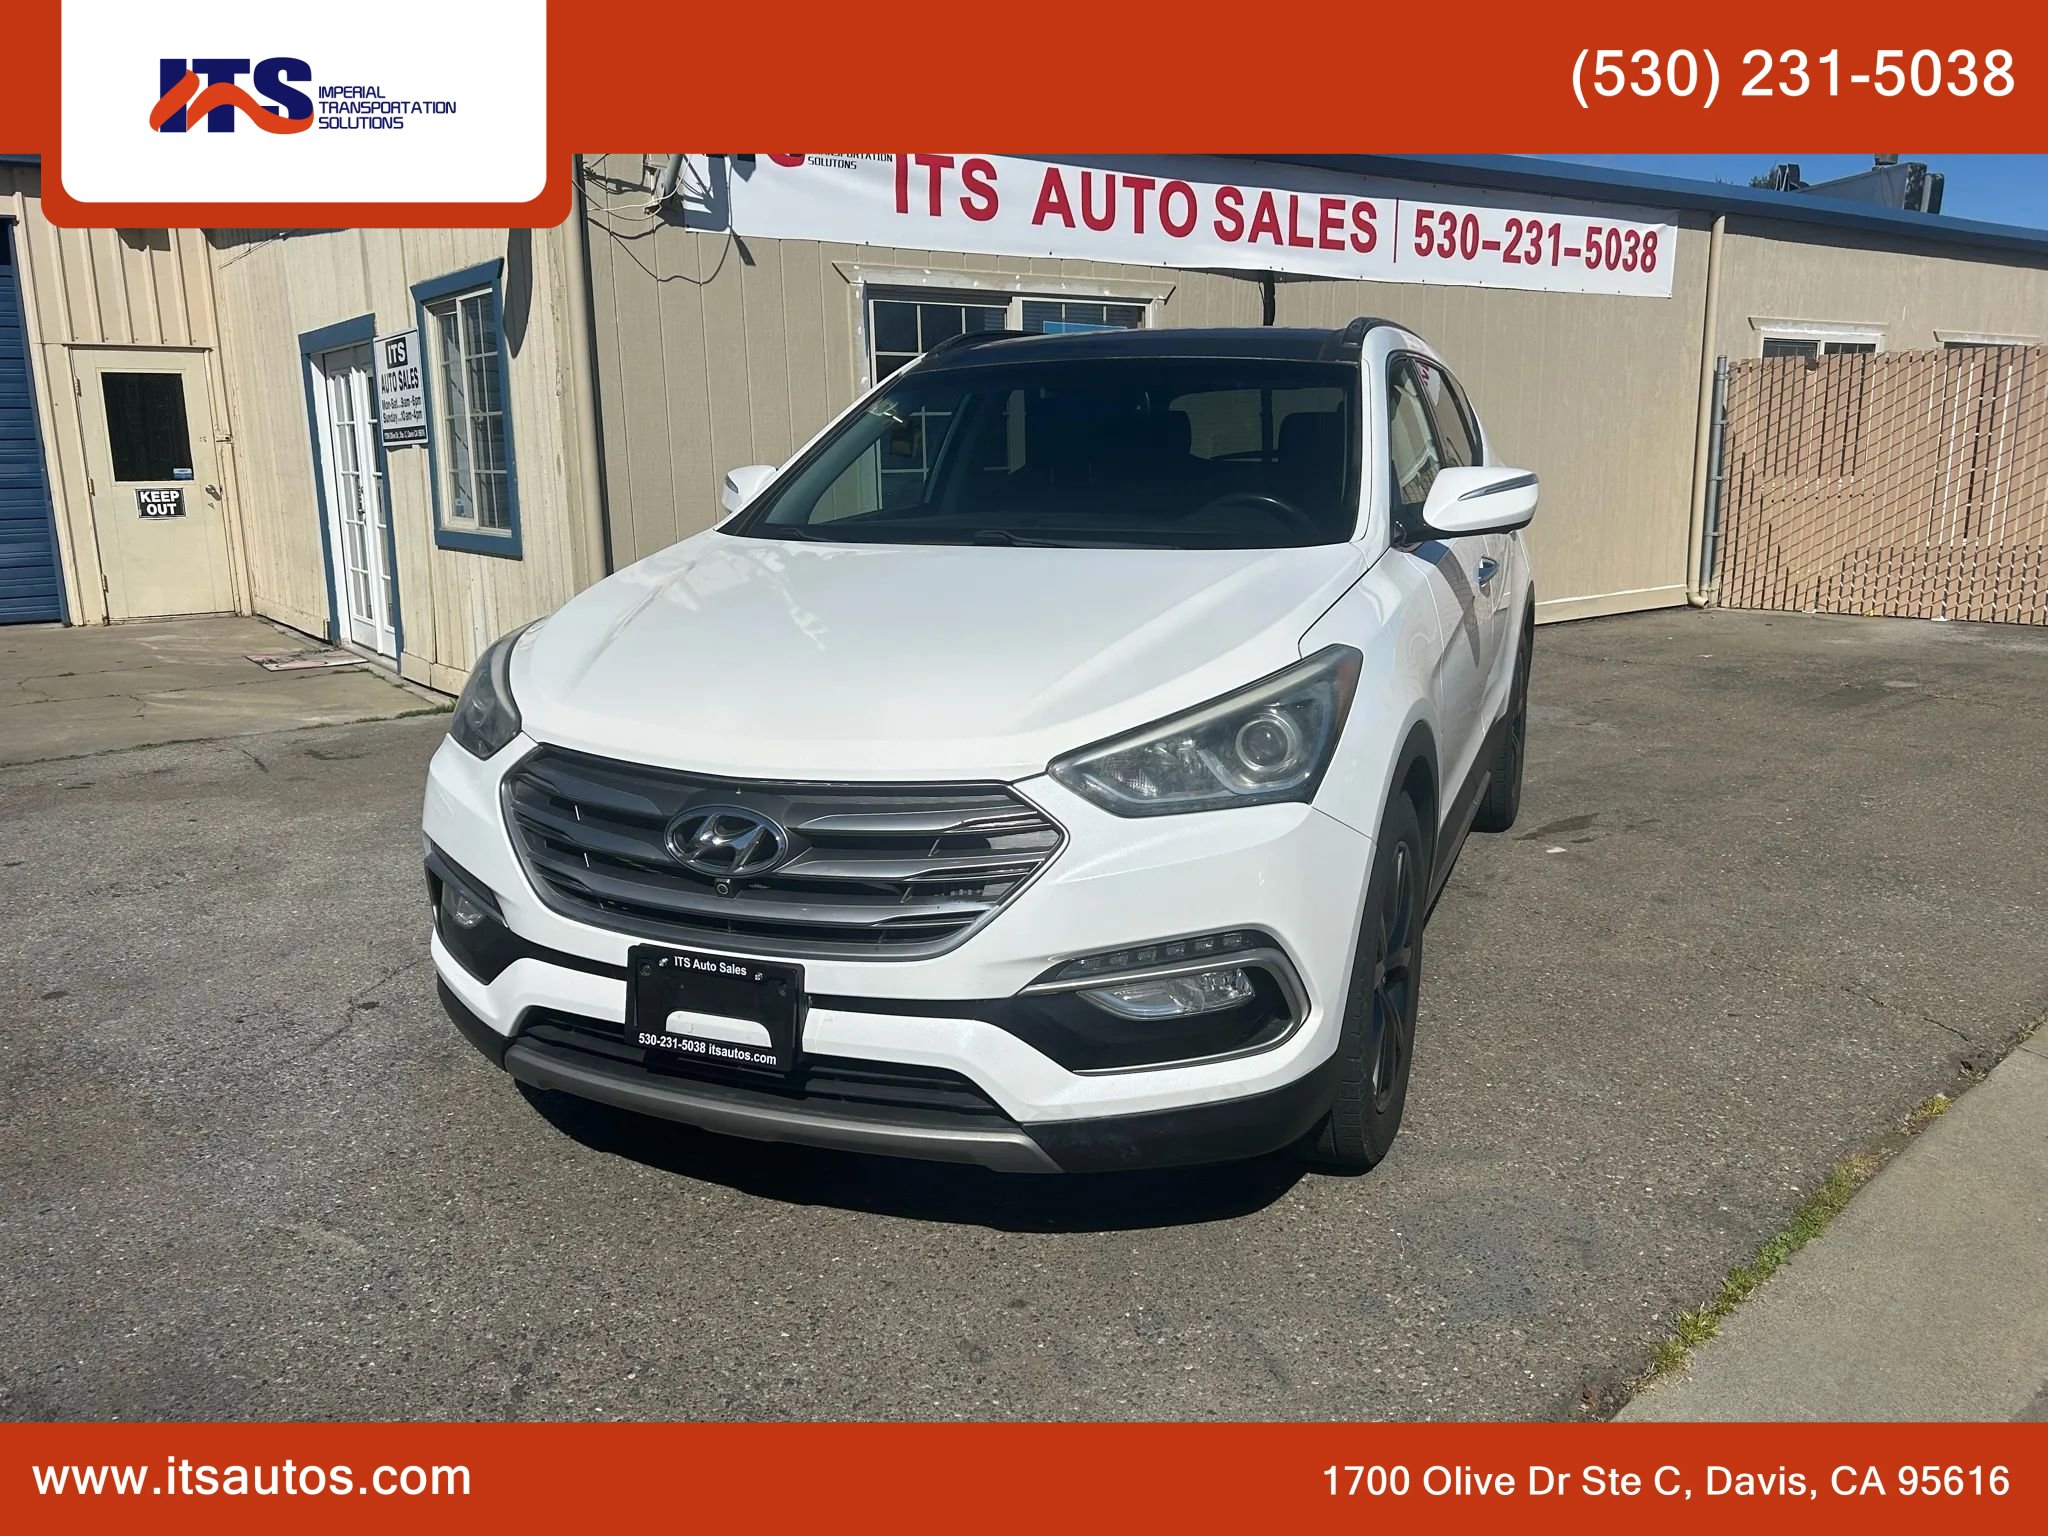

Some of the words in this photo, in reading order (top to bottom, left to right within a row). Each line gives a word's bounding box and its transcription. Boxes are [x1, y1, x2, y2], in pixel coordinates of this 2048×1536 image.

[895, 153, 999, 222] ITS
[1032, 167, 1198, 238] AUTO
[1213, 185, 1377, 253] SALES
[1415, 209, 1658, 273] 530-231-5038
[387, 341, 406, 364] ITS
[381, 371, 397, 394] AUTO
[398, 367, 419, 391] SALES
[140, 490, 180, 503] KEEP
[146, 503, 177, 516] OUT
[673, 955, 691, 968] ITS
[693, 958, 717, 972] Auto
[719, 961, 747, 976] Sales
[638, 1032, 706, 1054] 530-231-5038
[708, 1043, 777, 1066] itsautos.com
